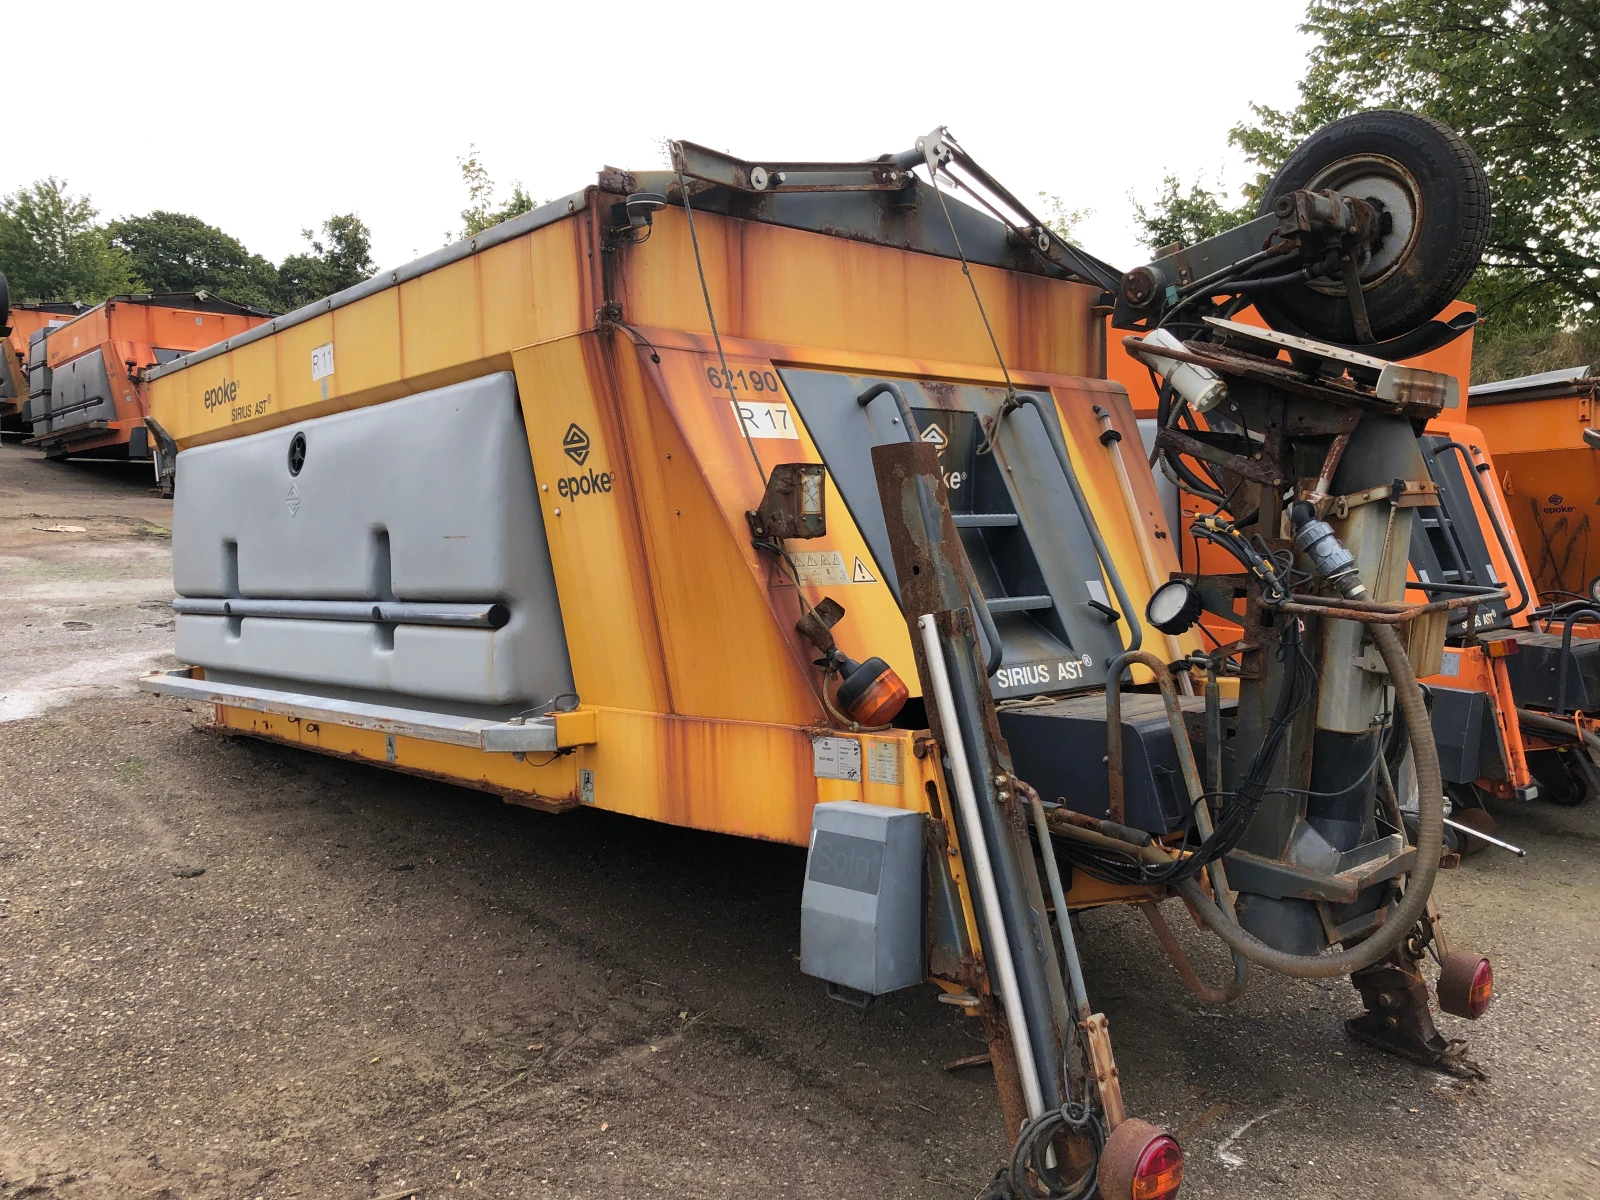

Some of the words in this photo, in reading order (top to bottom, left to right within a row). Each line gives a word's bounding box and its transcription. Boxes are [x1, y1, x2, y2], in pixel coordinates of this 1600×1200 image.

[312, 354, 320, 374] R
[706, 366, 779, 393] 62190
[231, 404, 252, 422] SIRIUS
[738, 407, 760, 429] R
[764, 408, 788, 430] 17
[996, 664, 1050, 688] SIRIUS
